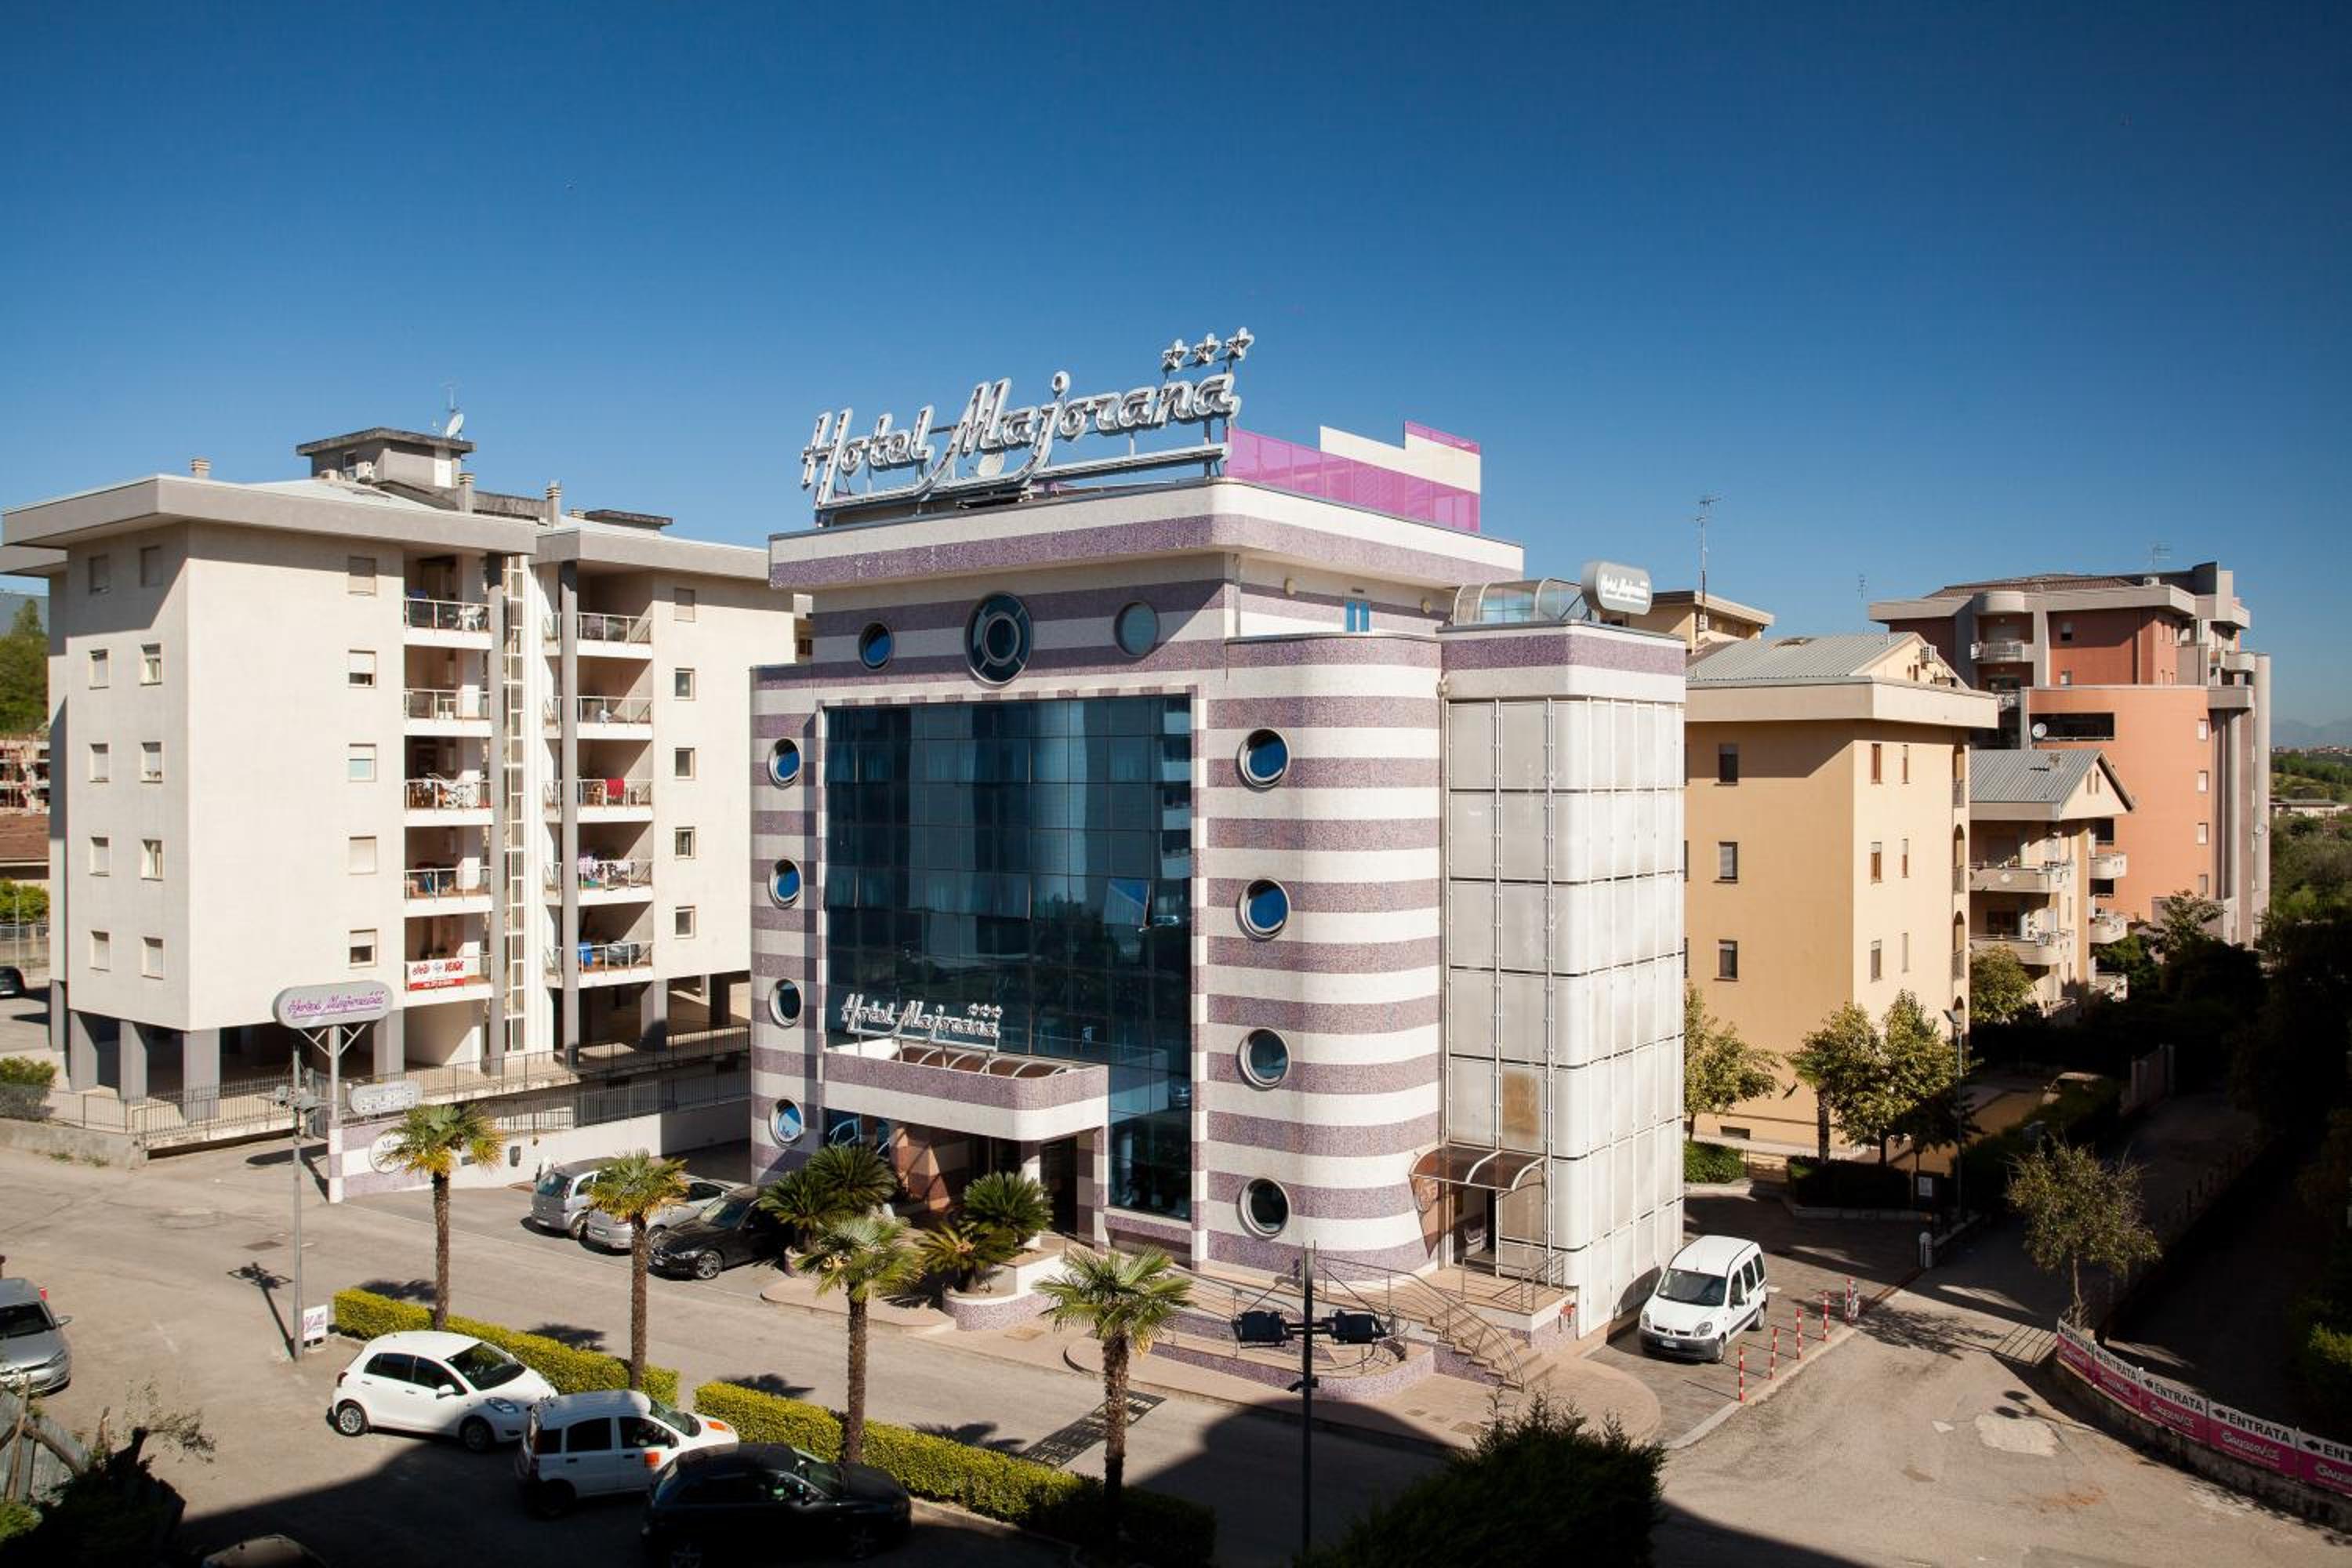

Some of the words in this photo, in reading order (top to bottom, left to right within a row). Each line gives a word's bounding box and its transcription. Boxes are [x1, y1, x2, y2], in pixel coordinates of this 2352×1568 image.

[801, 405, 935, 510] Hotel
[928, 371, 1240, 492] Majorana
[840, 993, 897, 1034] Hotel
[894, 1000, 1000, 1041] Majorana
[2155, 1381, 2204, 1412] ENTRATA
[2228, 1414, 2291, 1443] ENTRATA
